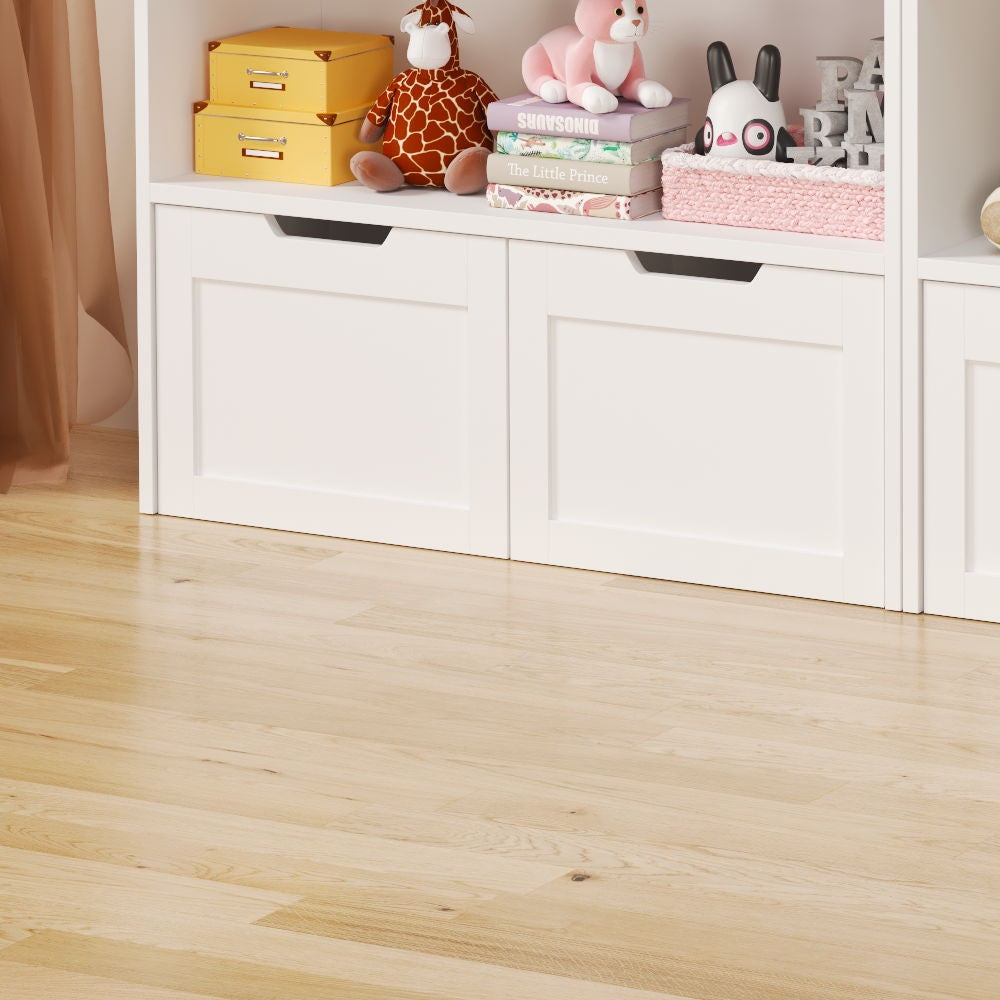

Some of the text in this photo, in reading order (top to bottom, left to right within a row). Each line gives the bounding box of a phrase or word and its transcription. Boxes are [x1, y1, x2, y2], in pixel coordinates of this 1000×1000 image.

[517, 112, 600, 136] DINOSAURS
[507, 162, 609, 185] The Little Prince
